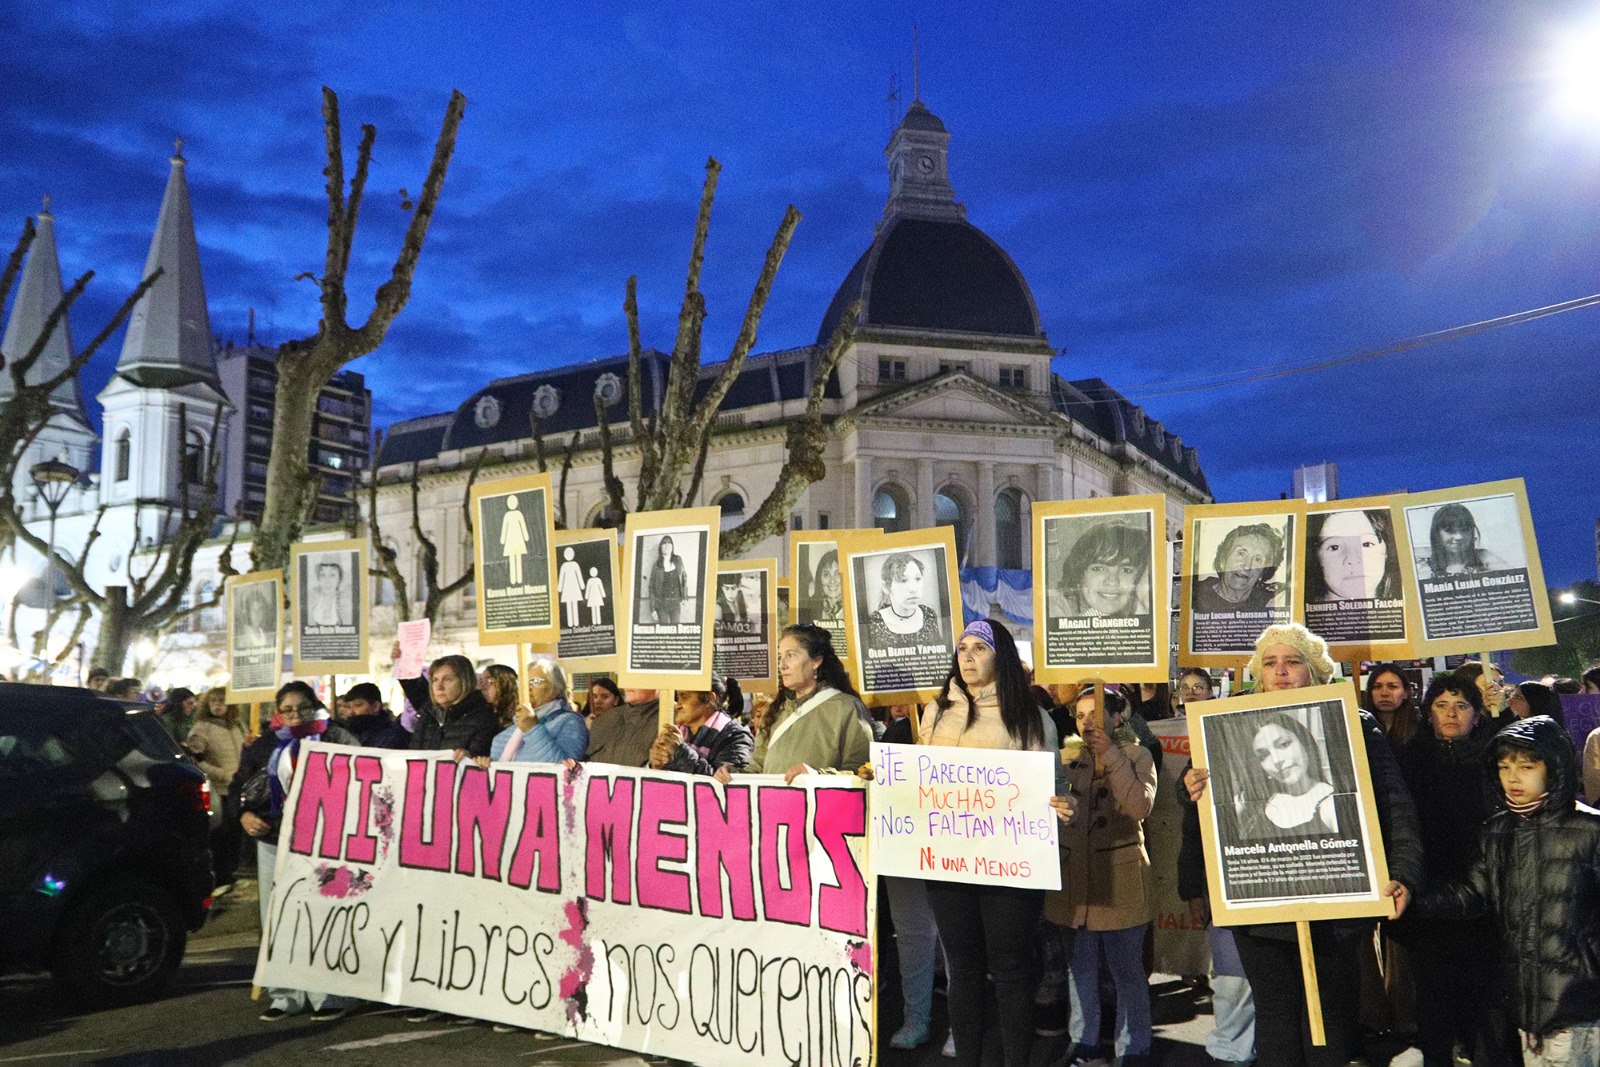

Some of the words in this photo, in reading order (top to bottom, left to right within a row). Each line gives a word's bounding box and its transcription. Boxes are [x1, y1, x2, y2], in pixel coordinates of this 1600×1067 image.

[1482, 574, 1525, 587] GONZÁLEZ
[1306, 603, 1338, 612] JENNIFER
[1339, 601, 1372, 610] SOLEDAD
[1374, 599, 1403, 609] FALCÓN
[678, 624, 701, 634] BUSTOS
[715, 621, 750, 633] CAM03
[1092, 617, 1139, 628] GIANGRECO
[868, 648, 887, 658] OLGA
[888, 646, 916, 657] BEATRIZ
[917, 645, 947, 654] YAPOUR
[875, 746, 906, 786] ¿TE
[918, 755, 1011, 786] PARECEMOS
[928, 811, 994, 838] FALTAN
[290, 752, 382, 865] NI
[398, 760, 563, 893] UNA
[585, 776, 868, 938] MENOS
[1224, 845, 1266, 856] Marcela
[1320, 838, 1358, 850] Gómez
[942, 858, 969, 872] UNA
[975, 857, 1032, 878] MENOS
[265, 877, 369, 973] Vivas
[410, 904, 554, 1010] Libres
[603, 937, 684, 1030] nos
